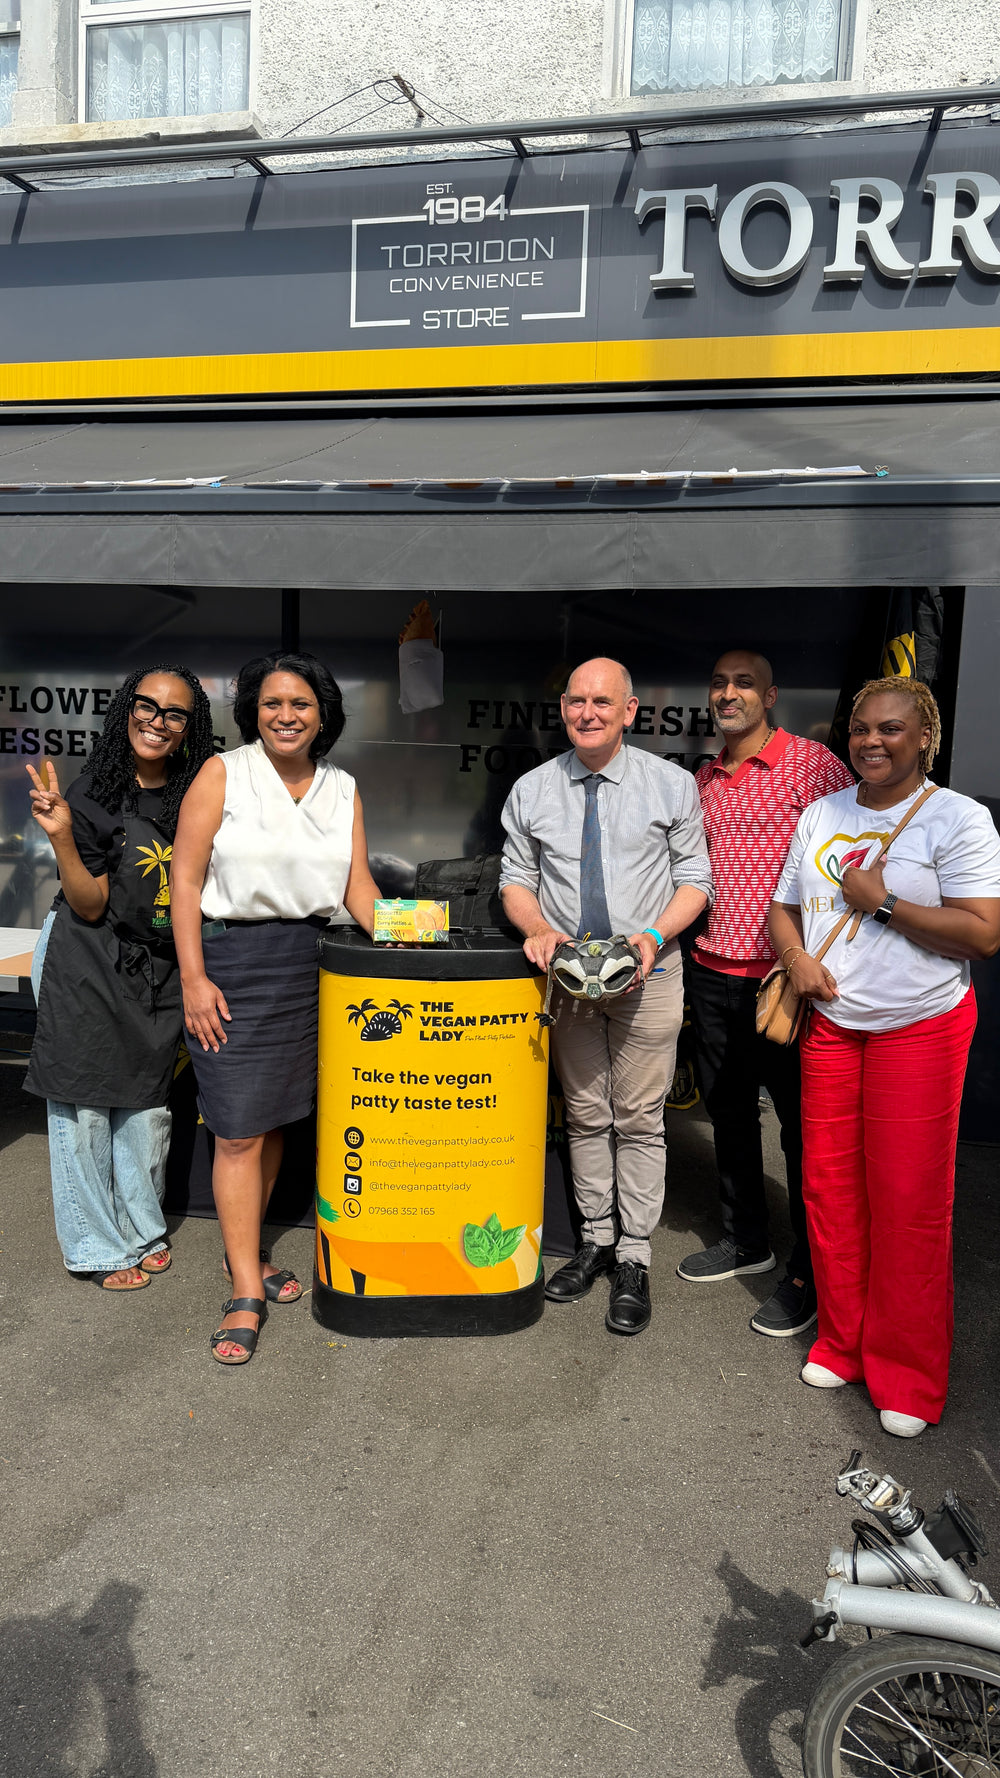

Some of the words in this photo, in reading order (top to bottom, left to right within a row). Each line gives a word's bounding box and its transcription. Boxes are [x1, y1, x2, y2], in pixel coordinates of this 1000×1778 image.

[427, 182, 454, 195] EST.
[422, 194, 508, 225] 1984
[381, 236, 555, 268] TORRIDON
[389, 271, 544, 293] CONVENIENCE
[422, 307, 510, 329] STORE
[0, 685, 120, 715] LOWE
[467, 700, 562, 731] FINE
[624, 705, 716, 737] ESH
[459, 744, 567, 775] FOO
[420, 1001, 454, 1013] THE
[420, 1015, 477, 1028] VEGAN
[479, 1012, 529, 1026] PATTY
[419, 1030, 464, 1042] LADY
[352, 1067, 395, 1084] Take
[399, 1071, 430, 1085] the
[434, 1072, 492, 1090] vegan
[351, 1093, 399, 1113] patty
[404, 1096, 452, 1110] taste
[456, 1094, 497, 1109] test!
[370, 1133, 515, 1147] www.theveganpattylady.co.uk
[369, 1157, 516, 1170] info@theveganpattylady.co.uk
[369, 1181, 472, 1192] @theveganpattylady
[368, 1206, 399, 1215] 07968
[400, 1207, 418, 1216] 352
[420, 1207, 435, 1216] 165
